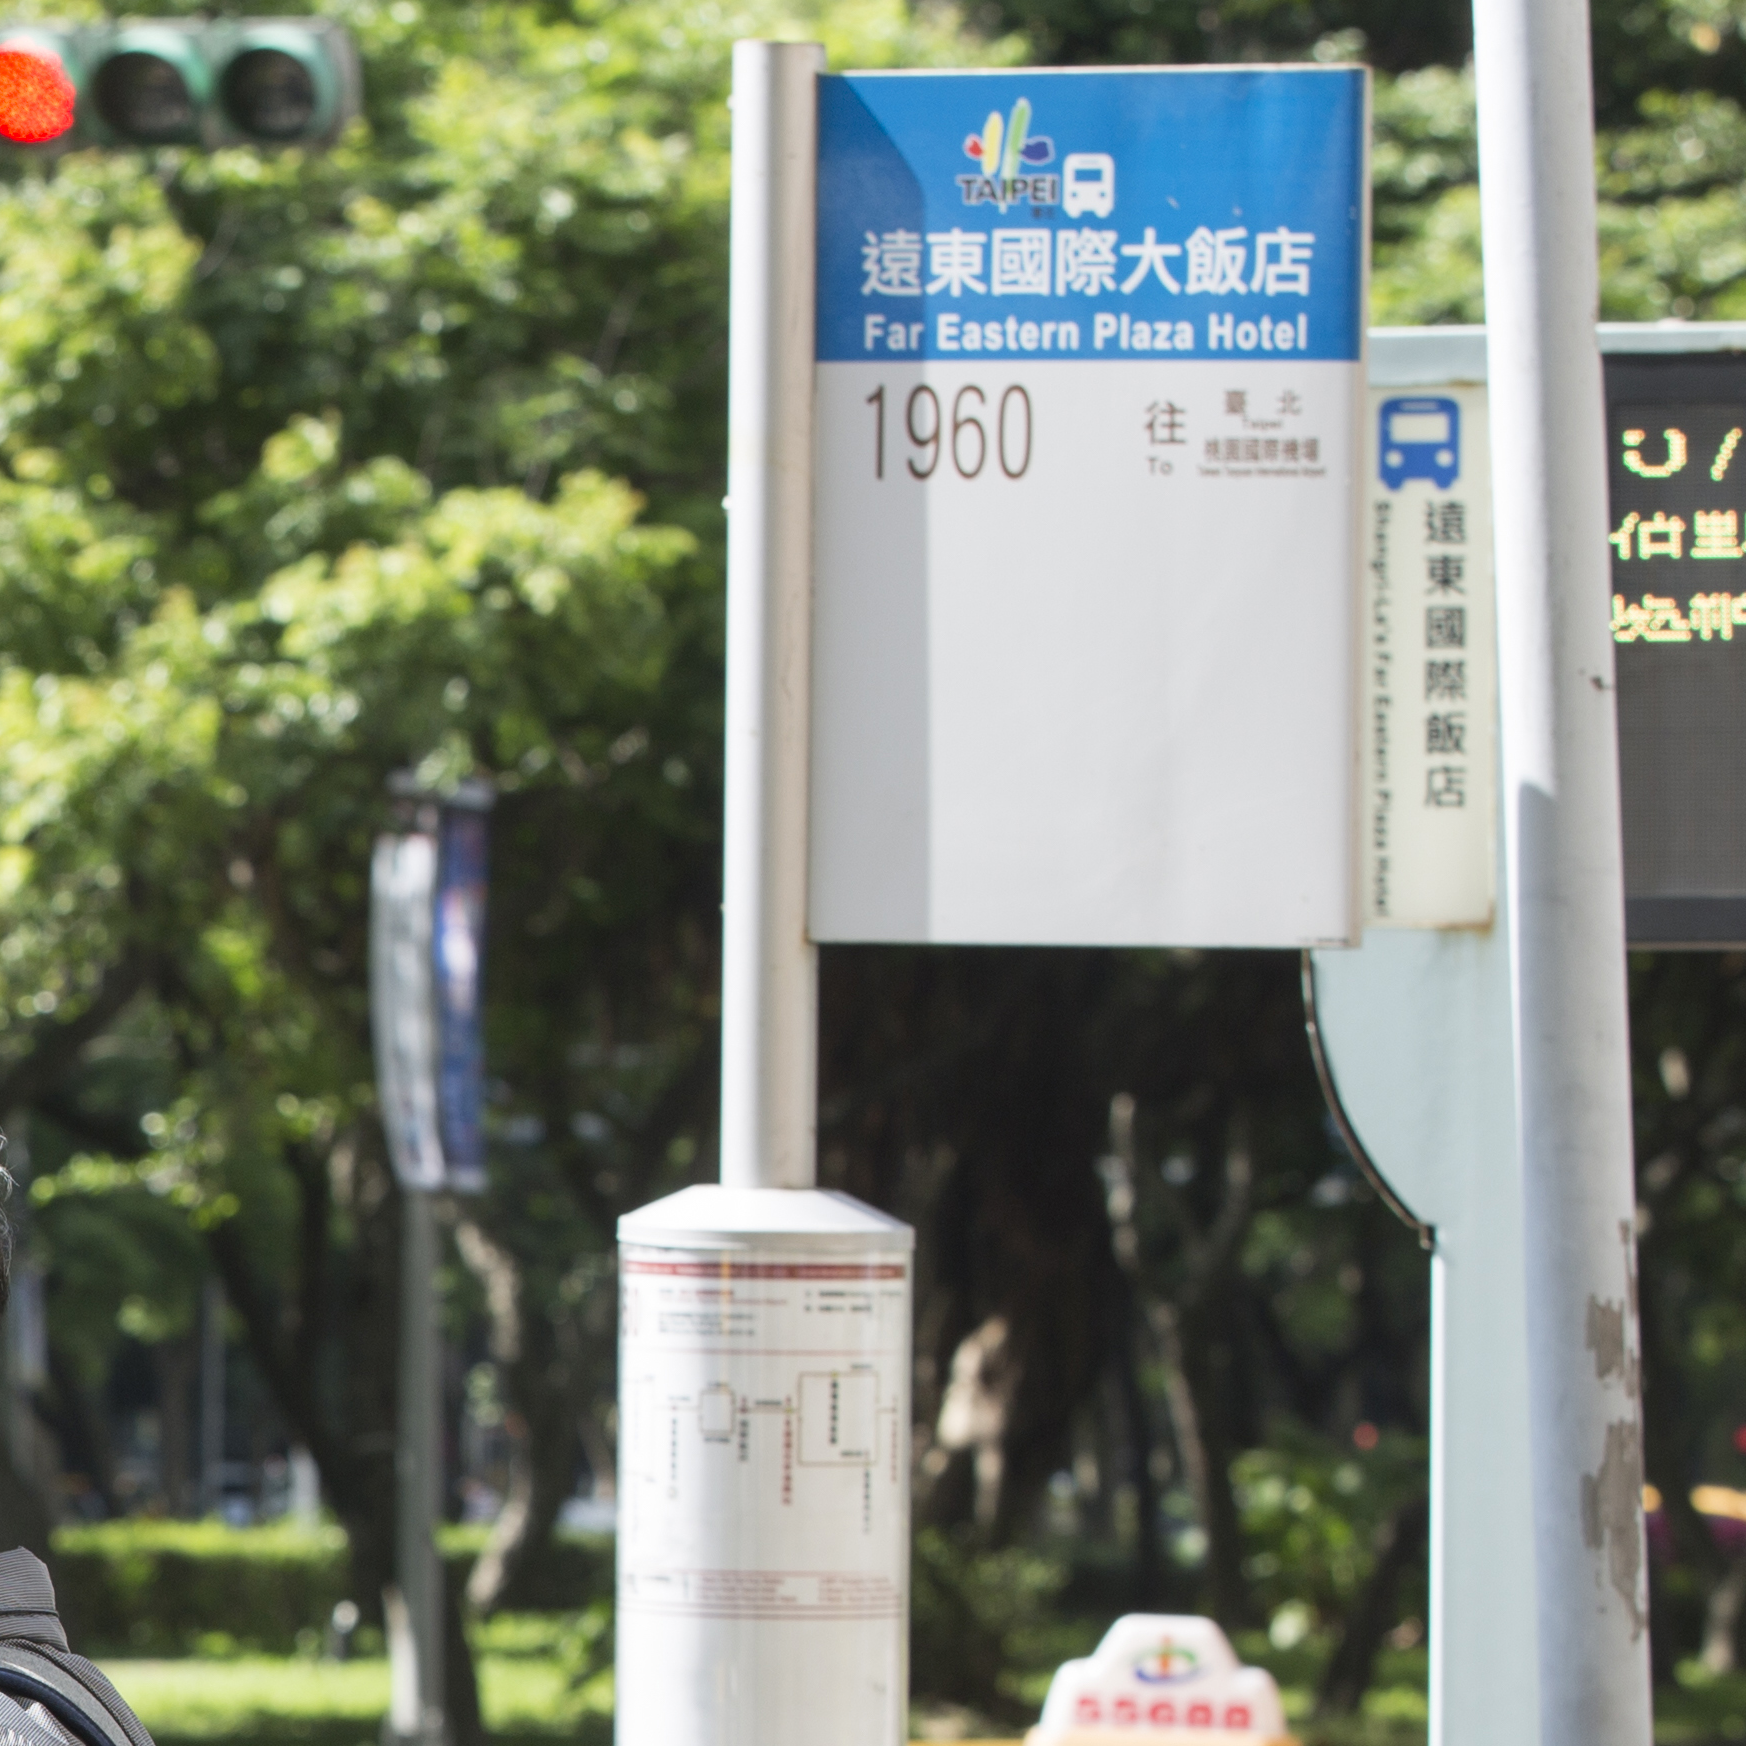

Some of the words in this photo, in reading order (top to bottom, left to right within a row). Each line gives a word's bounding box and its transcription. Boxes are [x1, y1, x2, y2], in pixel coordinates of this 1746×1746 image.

[957, 174, 1059, 205] TAIPEI
[861, 226, 1315, 297] 遠東國際大飯店
[864, 313, 925, 352] Far
[936, 313, 1080, 352] Eastern
[1093, 313, 1195, 352] Plaza
[1208, 313, 1308, 352] Hotel
[866, 384, 1032, 480] 1960
[1144, 400, 1187, 445] 往
[1146, 455, 1174, 476] To
[1423, 502, 1467, 807] 遠東國際飯店
